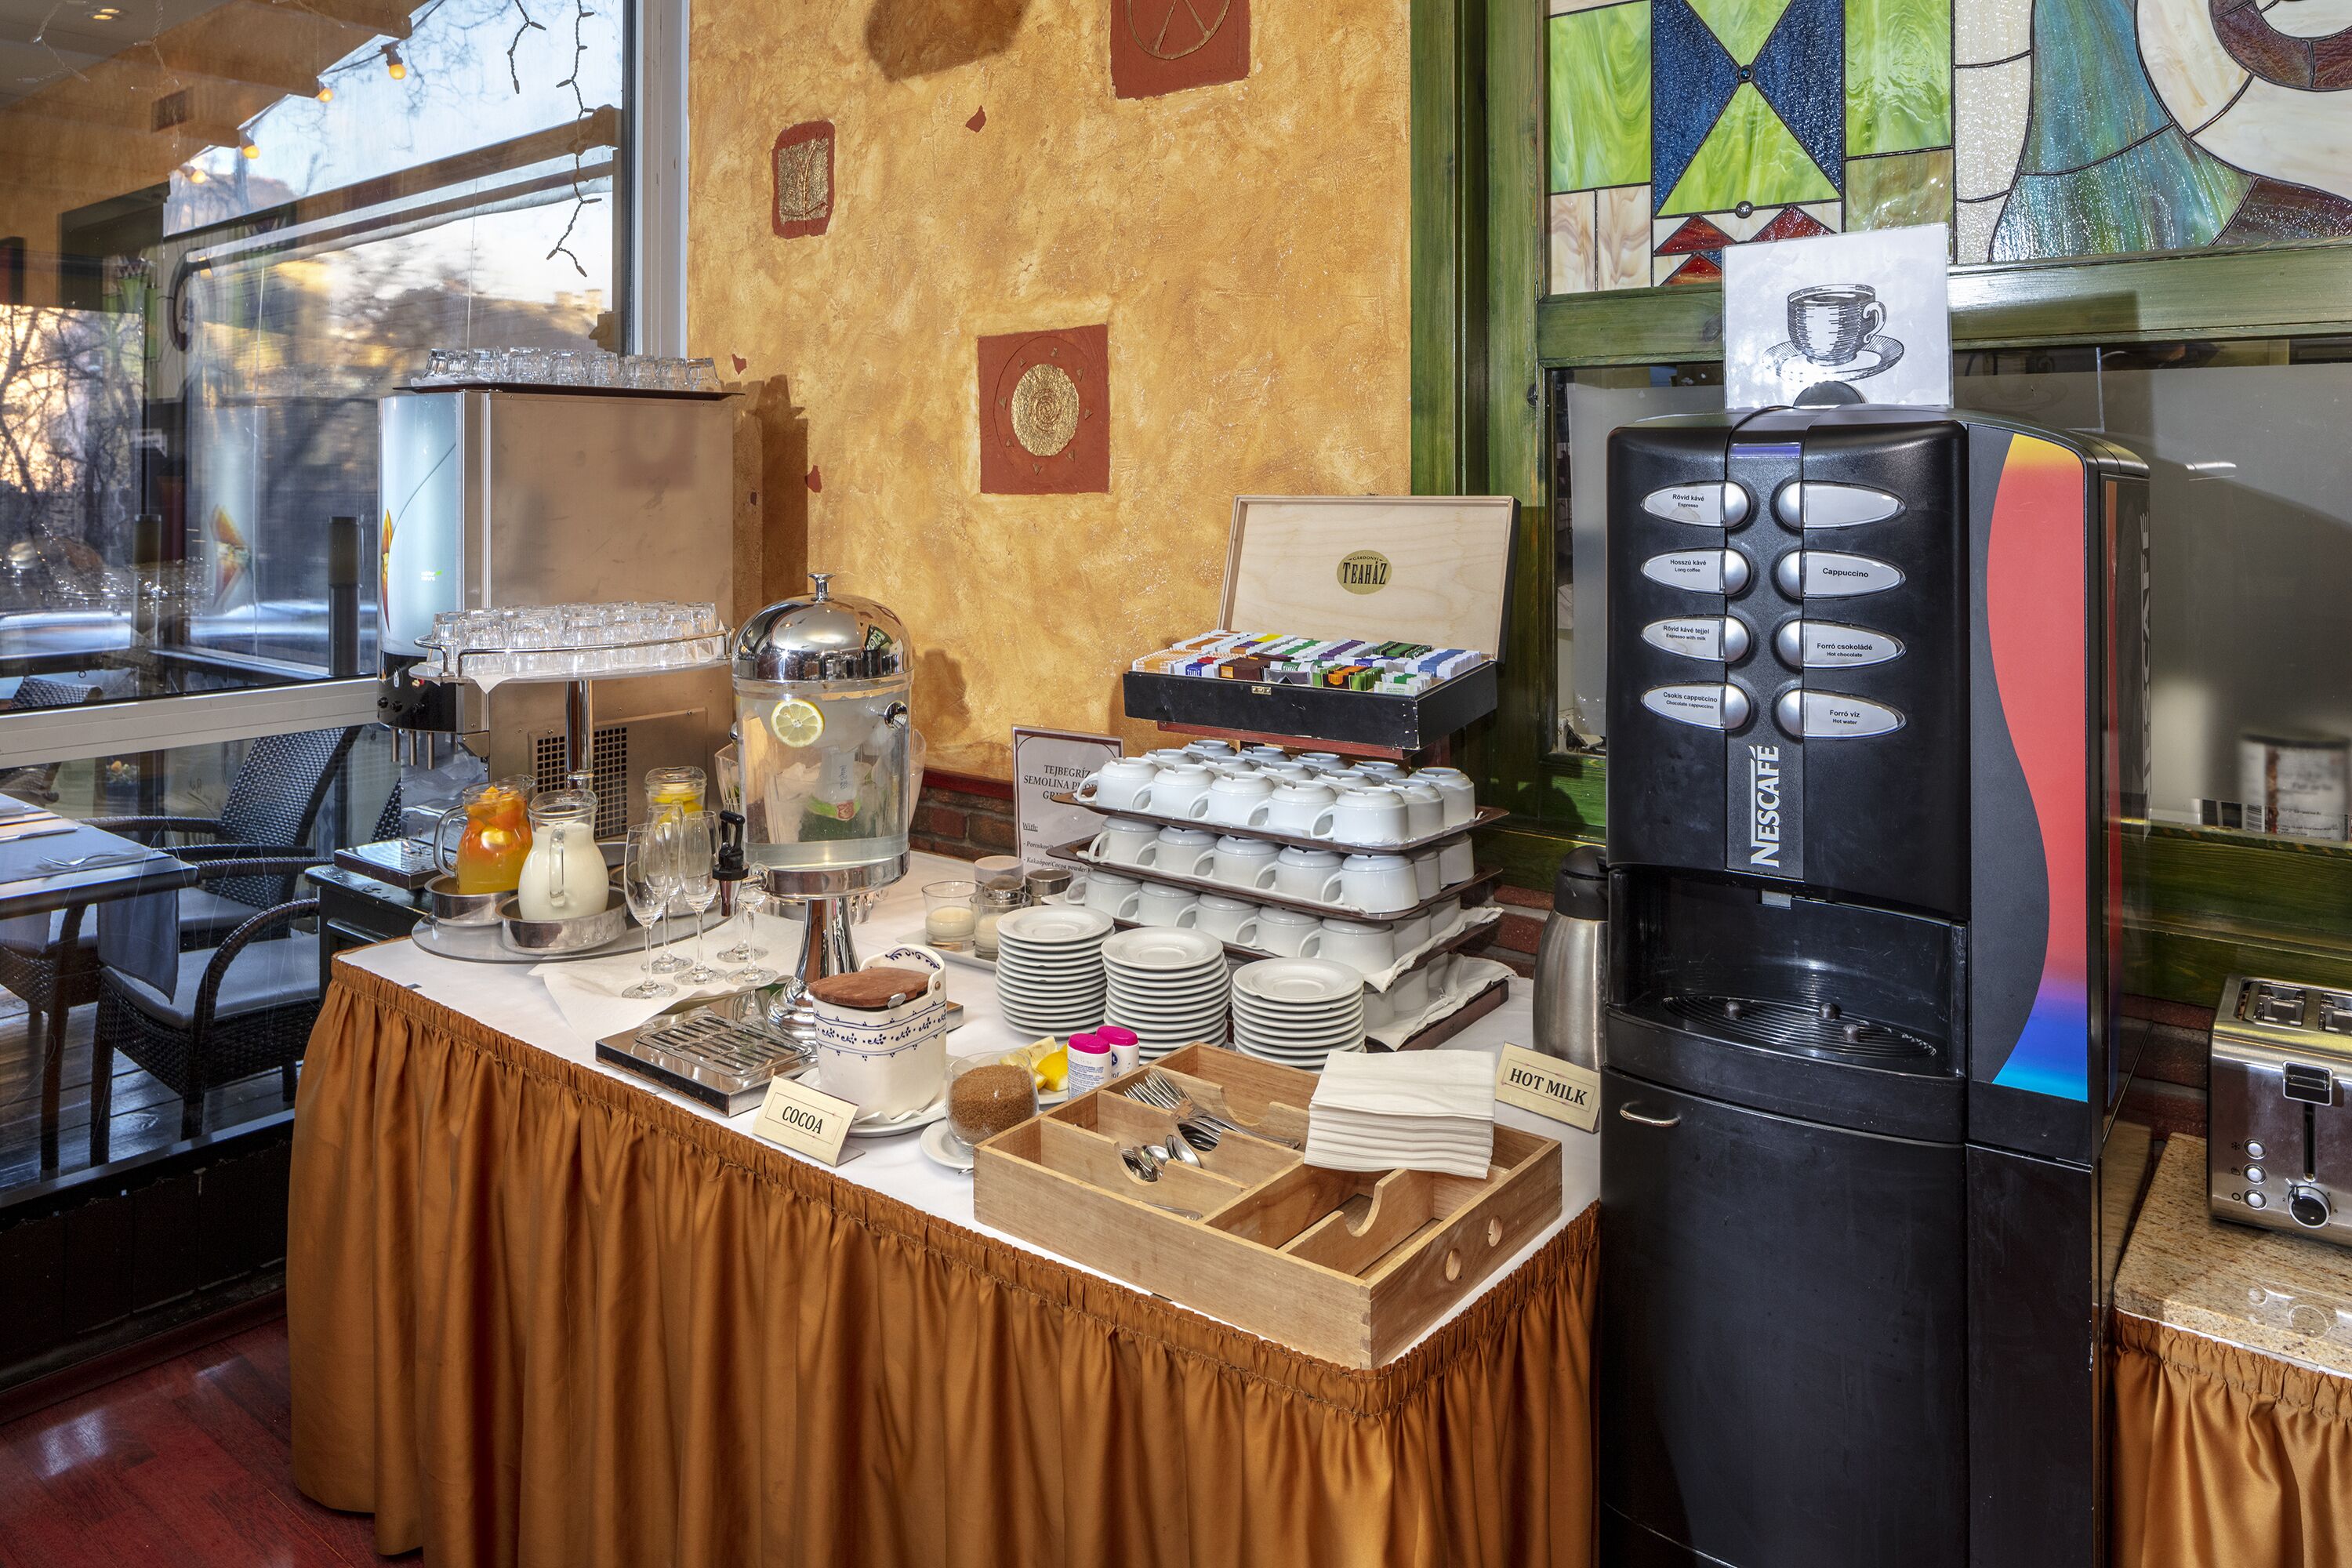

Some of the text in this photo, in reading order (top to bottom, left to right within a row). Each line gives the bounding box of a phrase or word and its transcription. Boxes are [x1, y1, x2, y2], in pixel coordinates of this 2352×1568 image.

[1342, 561, 1388, 585] TEAHÁZ
[1823, 568, 1869, 578] Cappuccino
[1044, 764, 1091, 778] TEJBEGRÍZ
[1023, 775, 1069, 789] SEMOLINA
[1748, 745, 1780, 869] NESCAFÉ
[1022, 822, 1038, 832] With:
[1501, 1068, 1588, 1106] HOT MILK
[782, 1105, 824, 1134] COCOA
